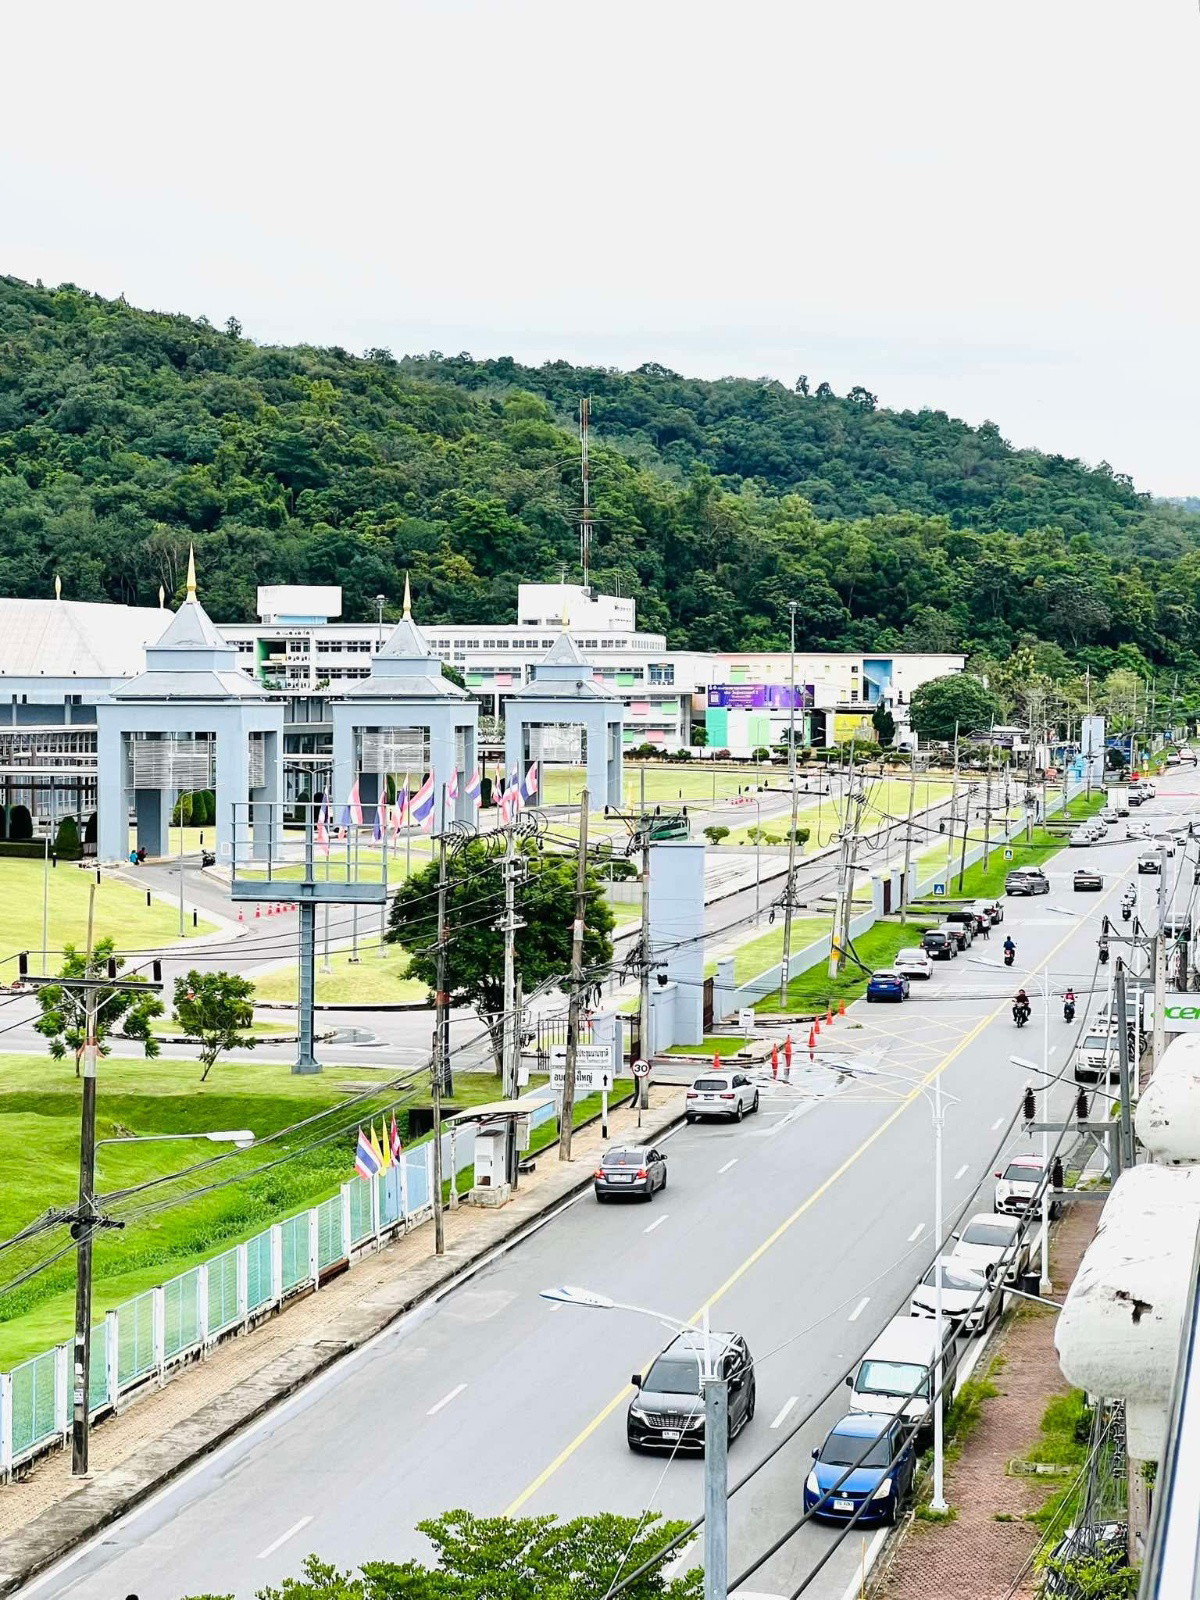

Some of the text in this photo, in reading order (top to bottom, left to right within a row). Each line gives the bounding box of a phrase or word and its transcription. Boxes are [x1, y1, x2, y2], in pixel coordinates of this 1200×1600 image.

[1151, 1006, 1200, 1020] cer
[576, 1048, 609, 1059] ประชุมนานาชาติ
[634, 1064, 647, 1073] 30
